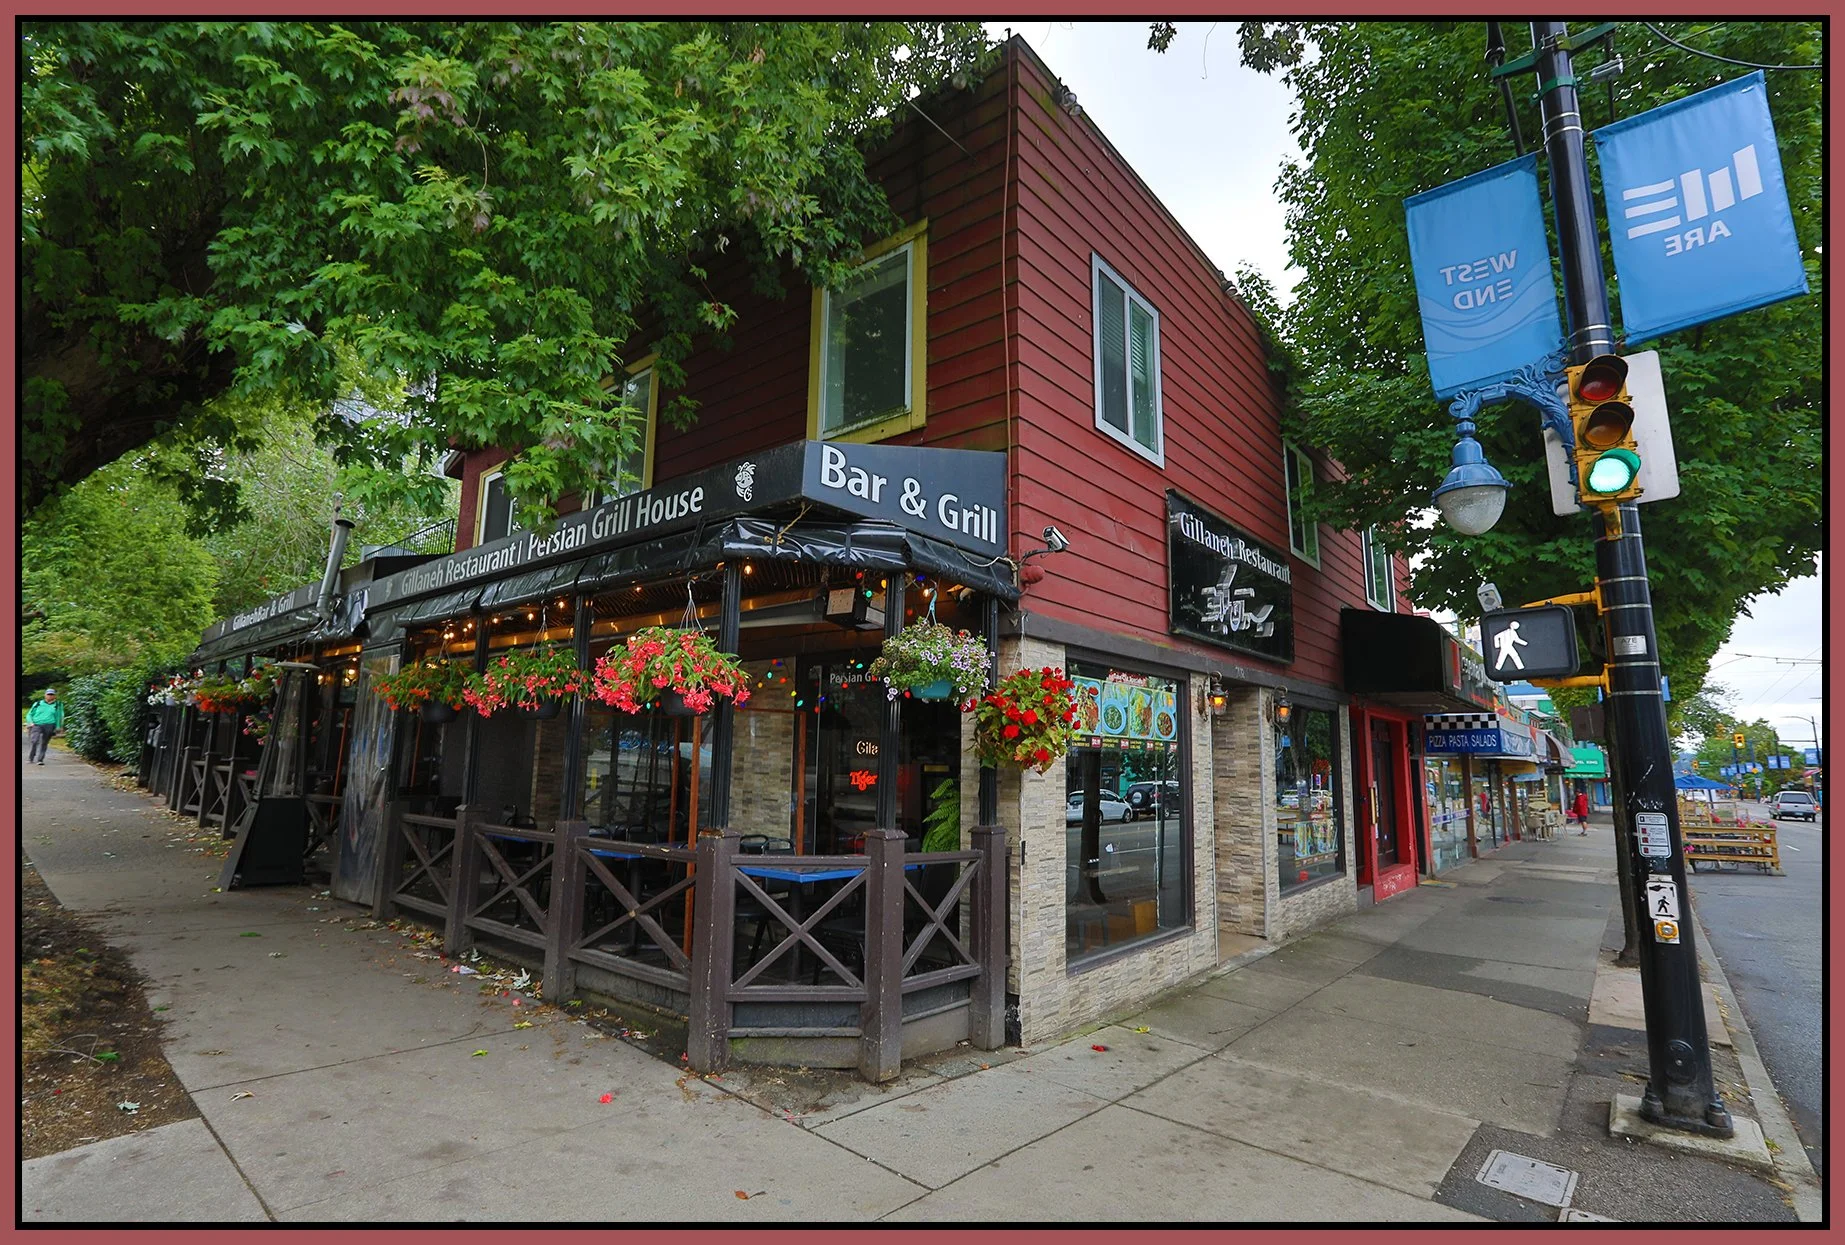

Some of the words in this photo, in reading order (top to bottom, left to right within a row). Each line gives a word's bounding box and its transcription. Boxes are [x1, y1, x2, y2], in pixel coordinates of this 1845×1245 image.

[820, 444, 888, 504] Bar
[899, 477, 928, 520] &
[937, 493, 997, 545] Grill
[401, 563, 444, 596] Gillaneh
[445, 544, 517, 584] Restaurant
[527, 522, 588, 562] Persian
[591, 499, 632, 541] Grill
[635, 486, 705, 530] House
[1180, 511, 1234, 560] Gillaneh
[1238, 538, 1292, 585] Restaurant
[277, 591, 296, 613] Grill
[1429, 735, 1447, 748] PIZZA
[1449, 735, 1470, 747] PASTA
[1471, 734, 1497, 747] SALADS
[849, 770, 879, 792] Tiger
